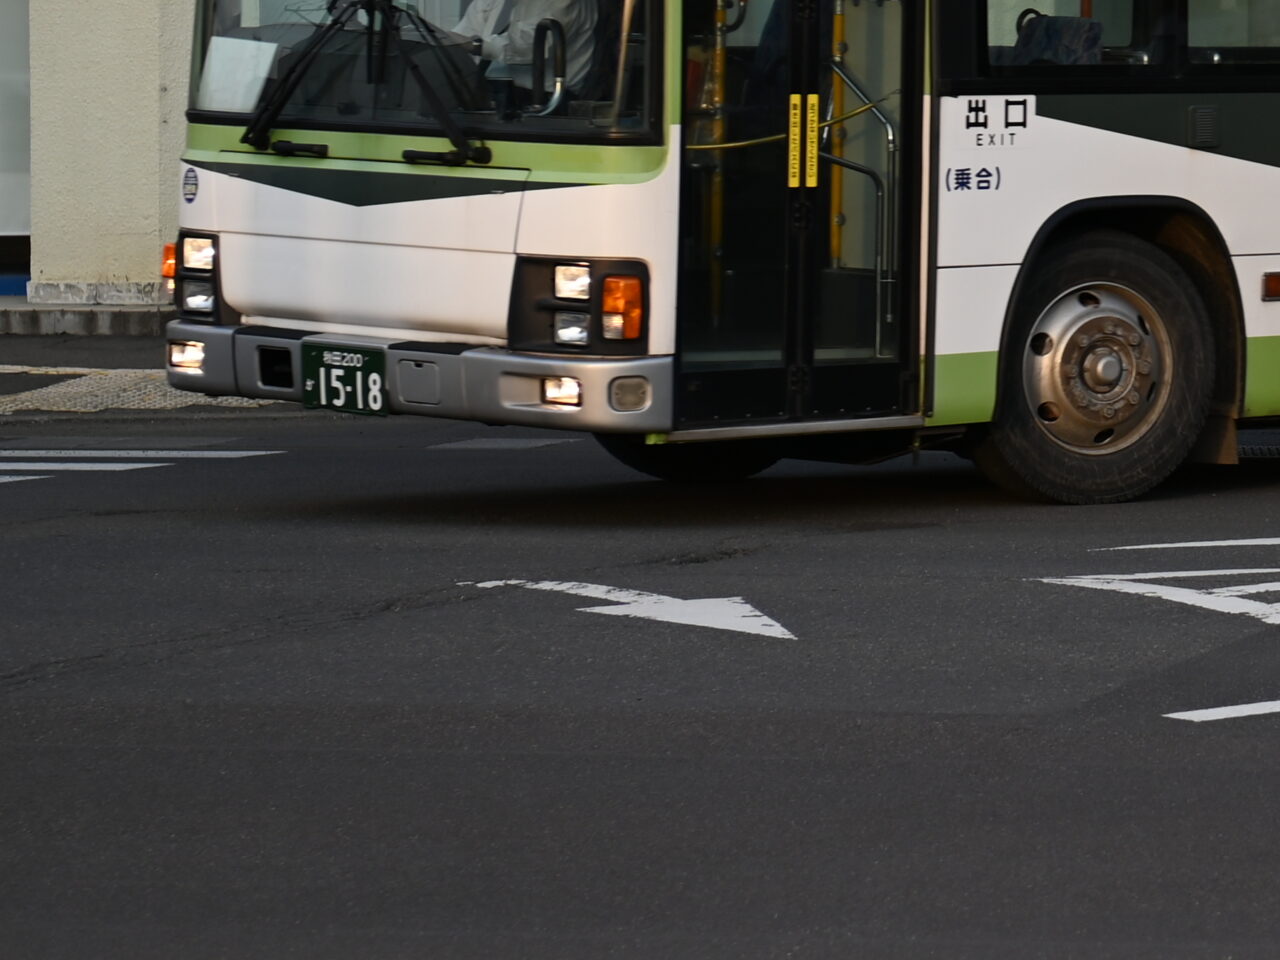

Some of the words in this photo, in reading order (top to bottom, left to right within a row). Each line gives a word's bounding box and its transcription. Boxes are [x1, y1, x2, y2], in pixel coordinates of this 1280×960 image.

[965, 99, 1027, 129] 出口
[976, 133, 1016, 146] EXIT
[946, 167, 1001, 192] (乗合)
[319, 367, 382, 410] 15-18
